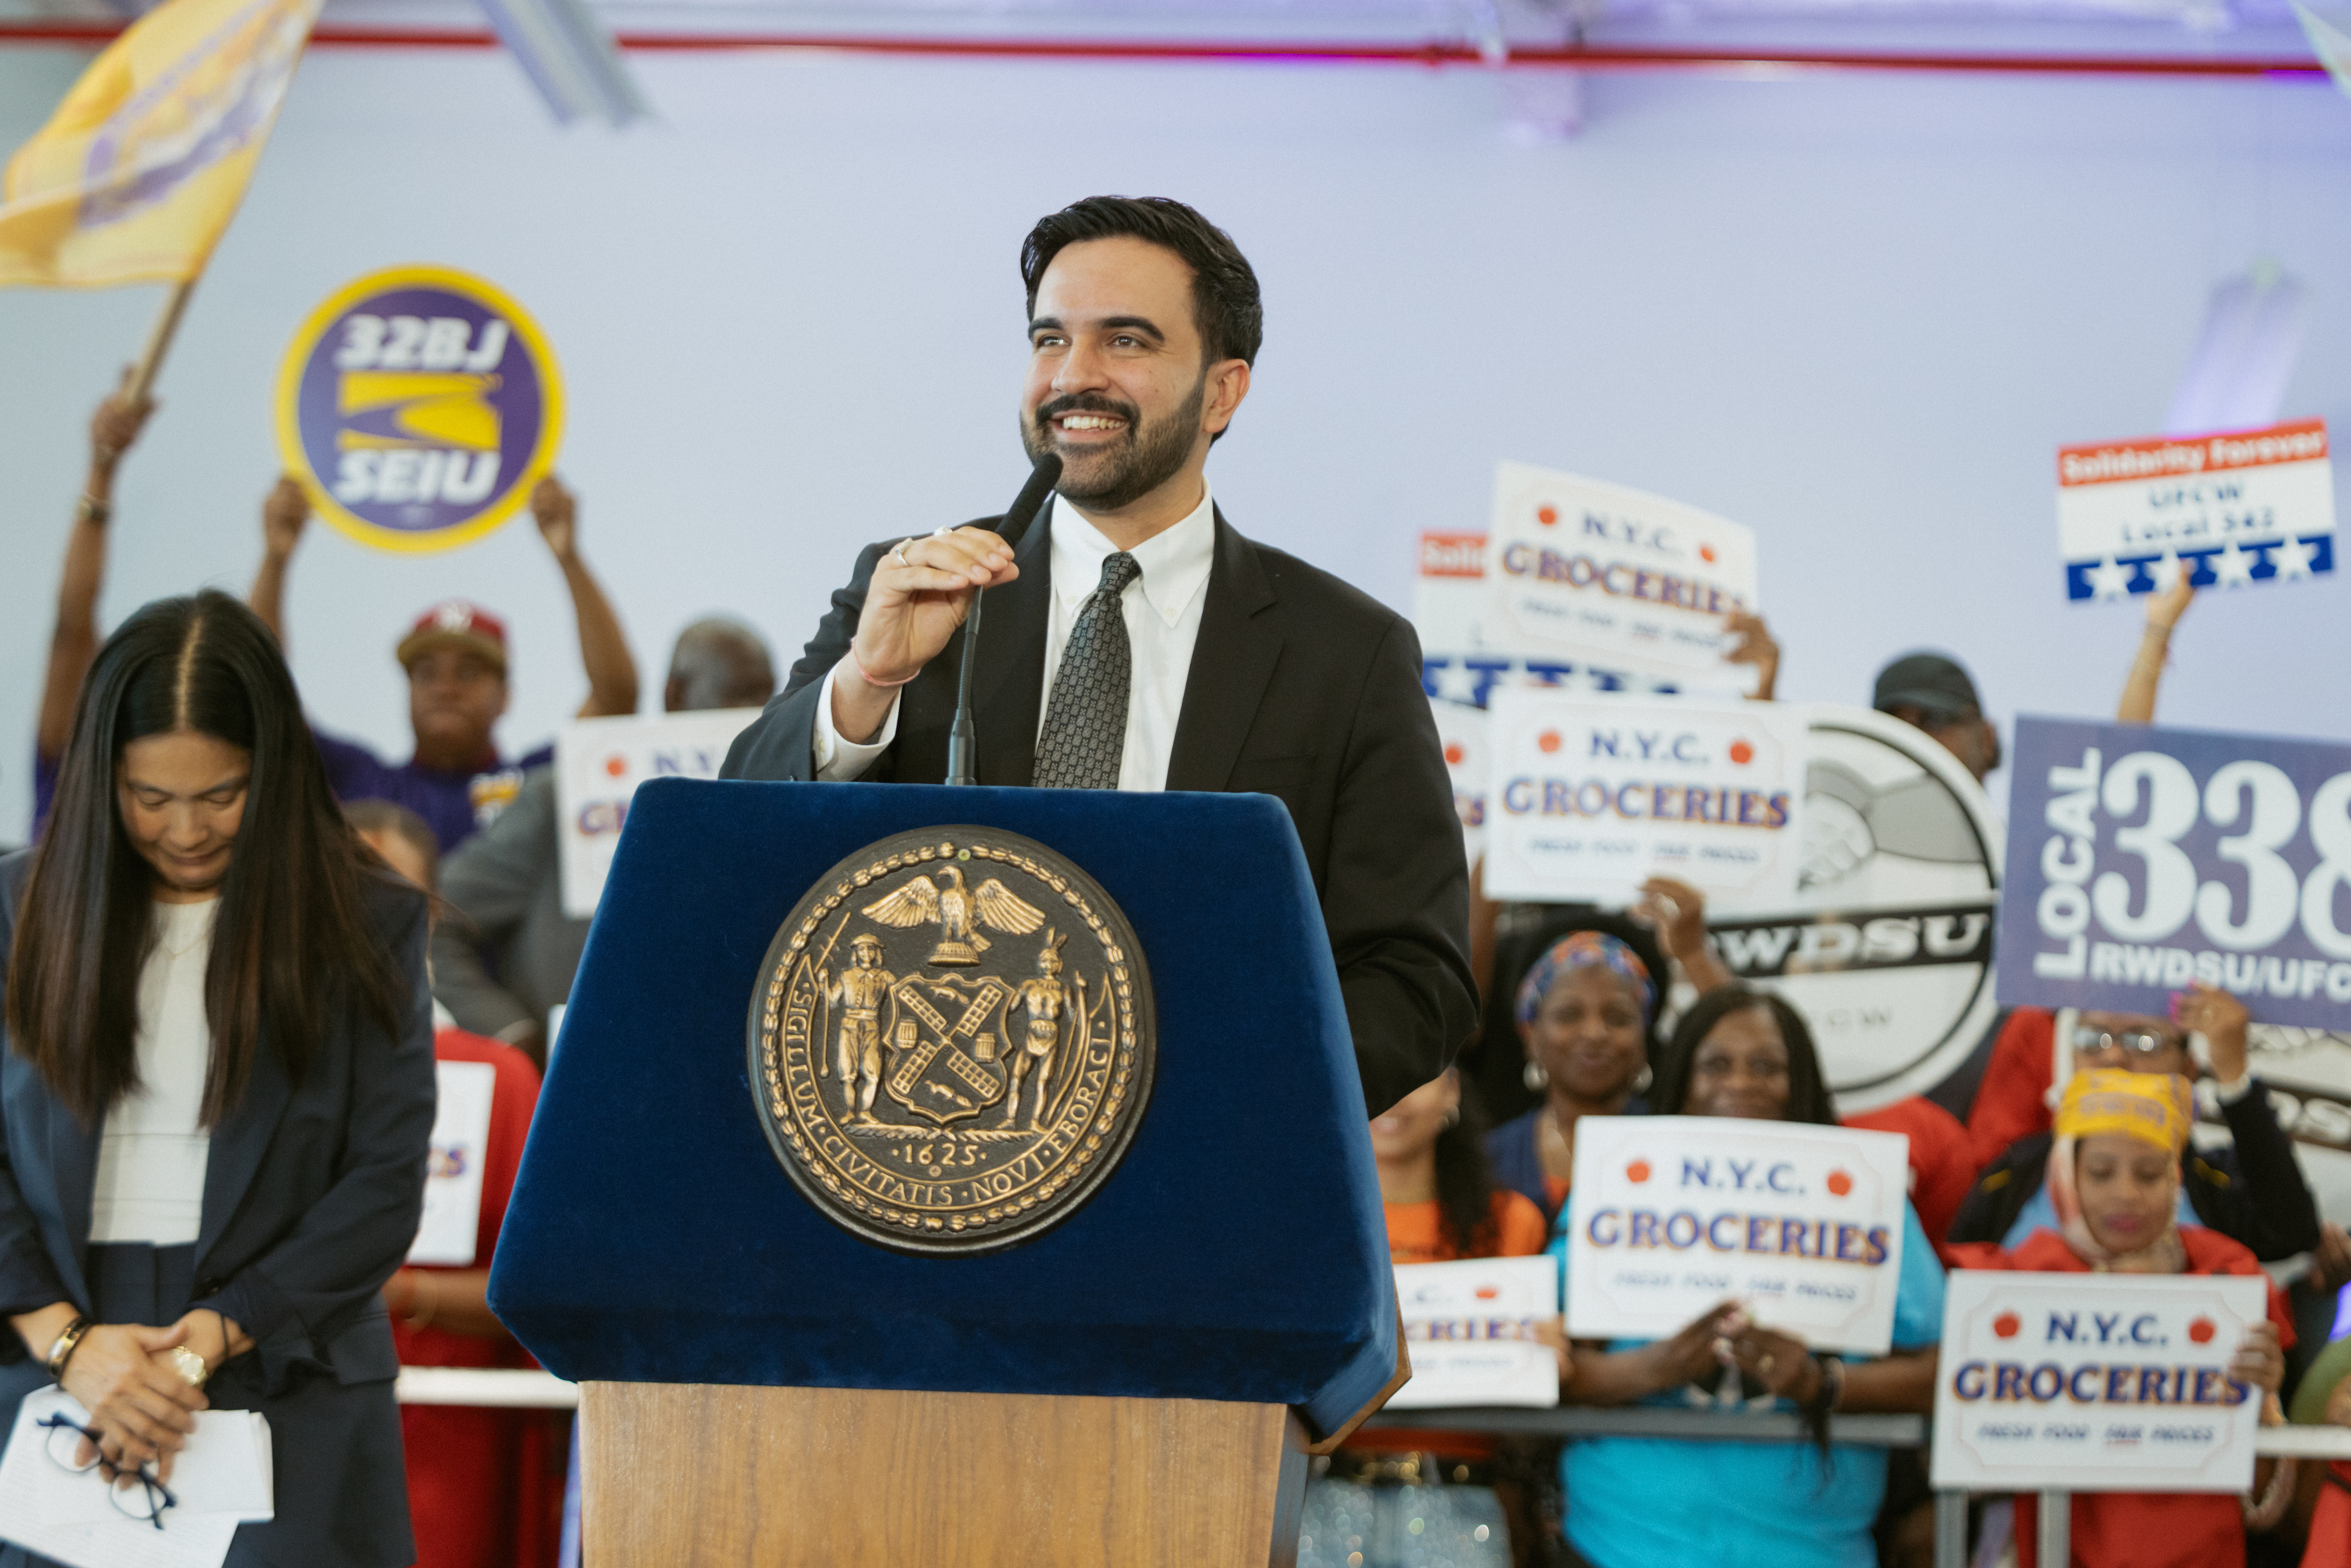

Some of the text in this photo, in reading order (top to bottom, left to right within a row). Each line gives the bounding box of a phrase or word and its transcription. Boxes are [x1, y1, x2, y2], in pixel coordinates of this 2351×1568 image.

[334, 314, 511, 373] 32BJ
[333, 449, 502, 505] SEIU
[1590, 728, 1710, 763] N.Y.C.
[1503, 776, 1791, 830] GROCERIES
[2033, 747, 2103, 980] LOCAL
[1705, 912, 1990, 972] WDSU
[787, 991, 1111, 1205] SIGILLUM CIVITATIS NOVI EBORACI
[905, 1143, 979, 1166] 1625
[1681, 1157, 1808, 1196] N.Y.C.
[1586, 1205, 1891, 1267] GROCERIES
[2046, 1310, 2170, 1348] N.Y.C.
[1953, 1359, 2251, 1407] GROCERIES
